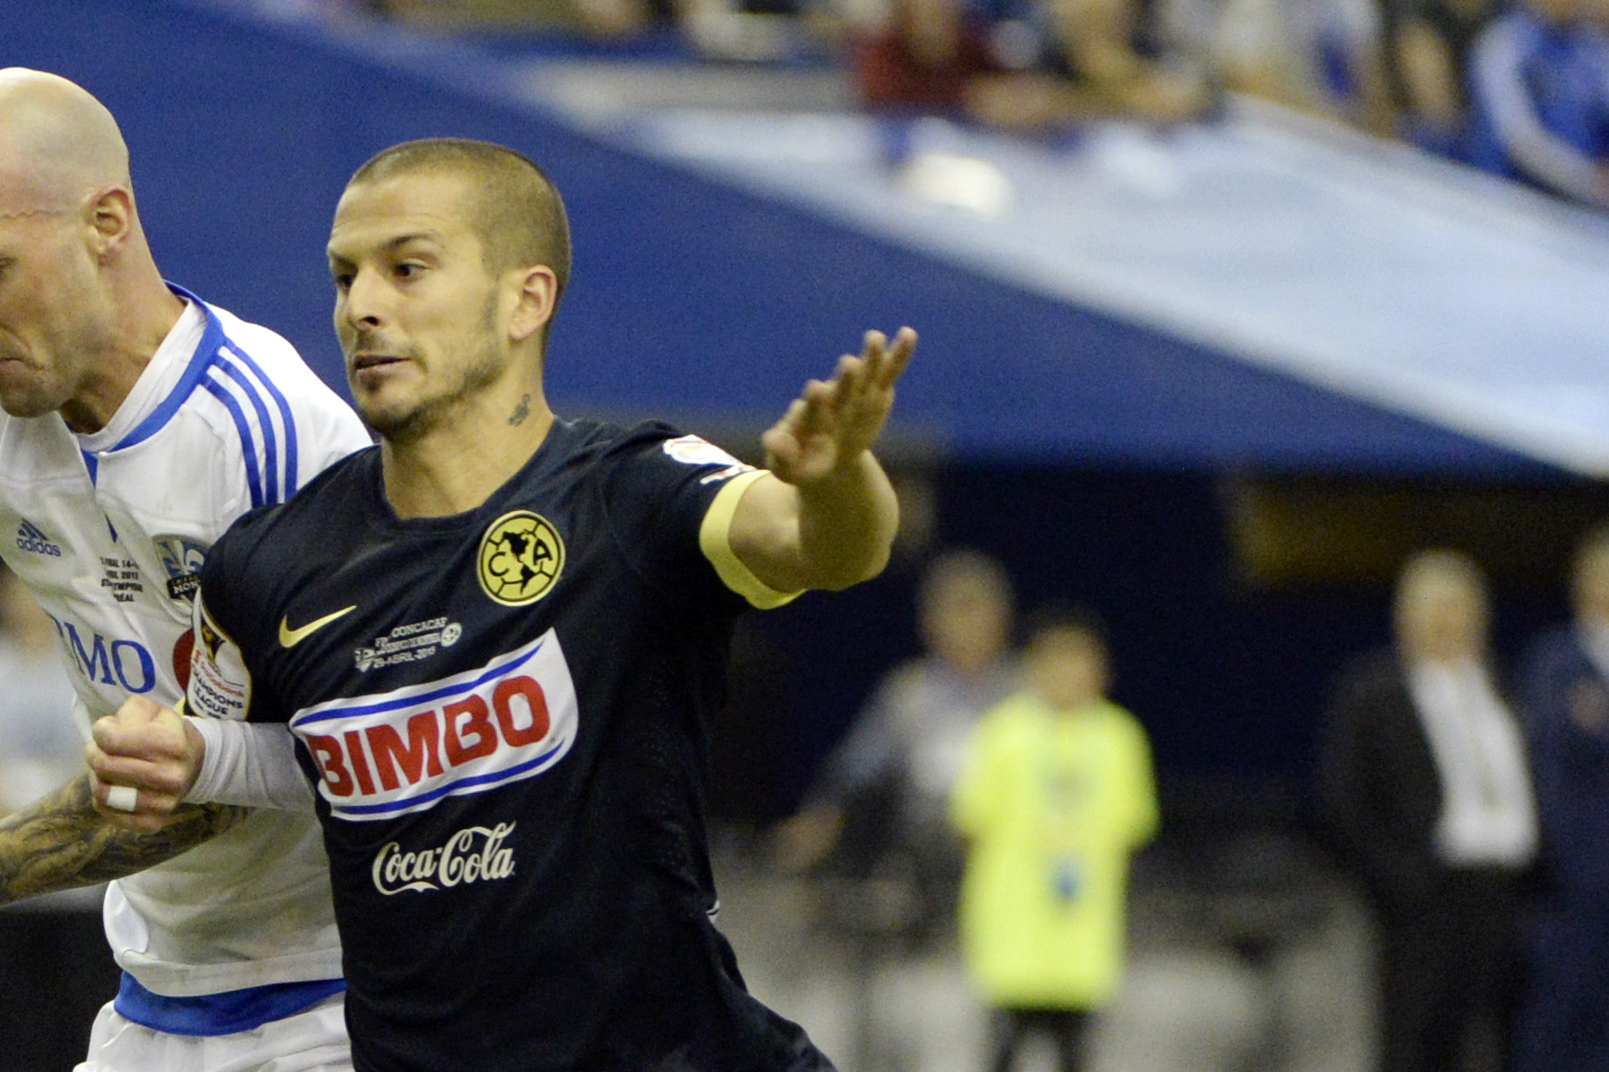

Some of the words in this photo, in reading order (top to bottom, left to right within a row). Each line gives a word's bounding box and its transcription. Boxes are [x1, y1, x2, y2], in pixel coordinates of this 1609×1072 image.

[16, 538, 61, 557] adidas
[391, 616, 448, 638] CONCACAF
[305, 675, 551, 797] BIMBO
[372, 820, 517, 895] Coca-Cola
